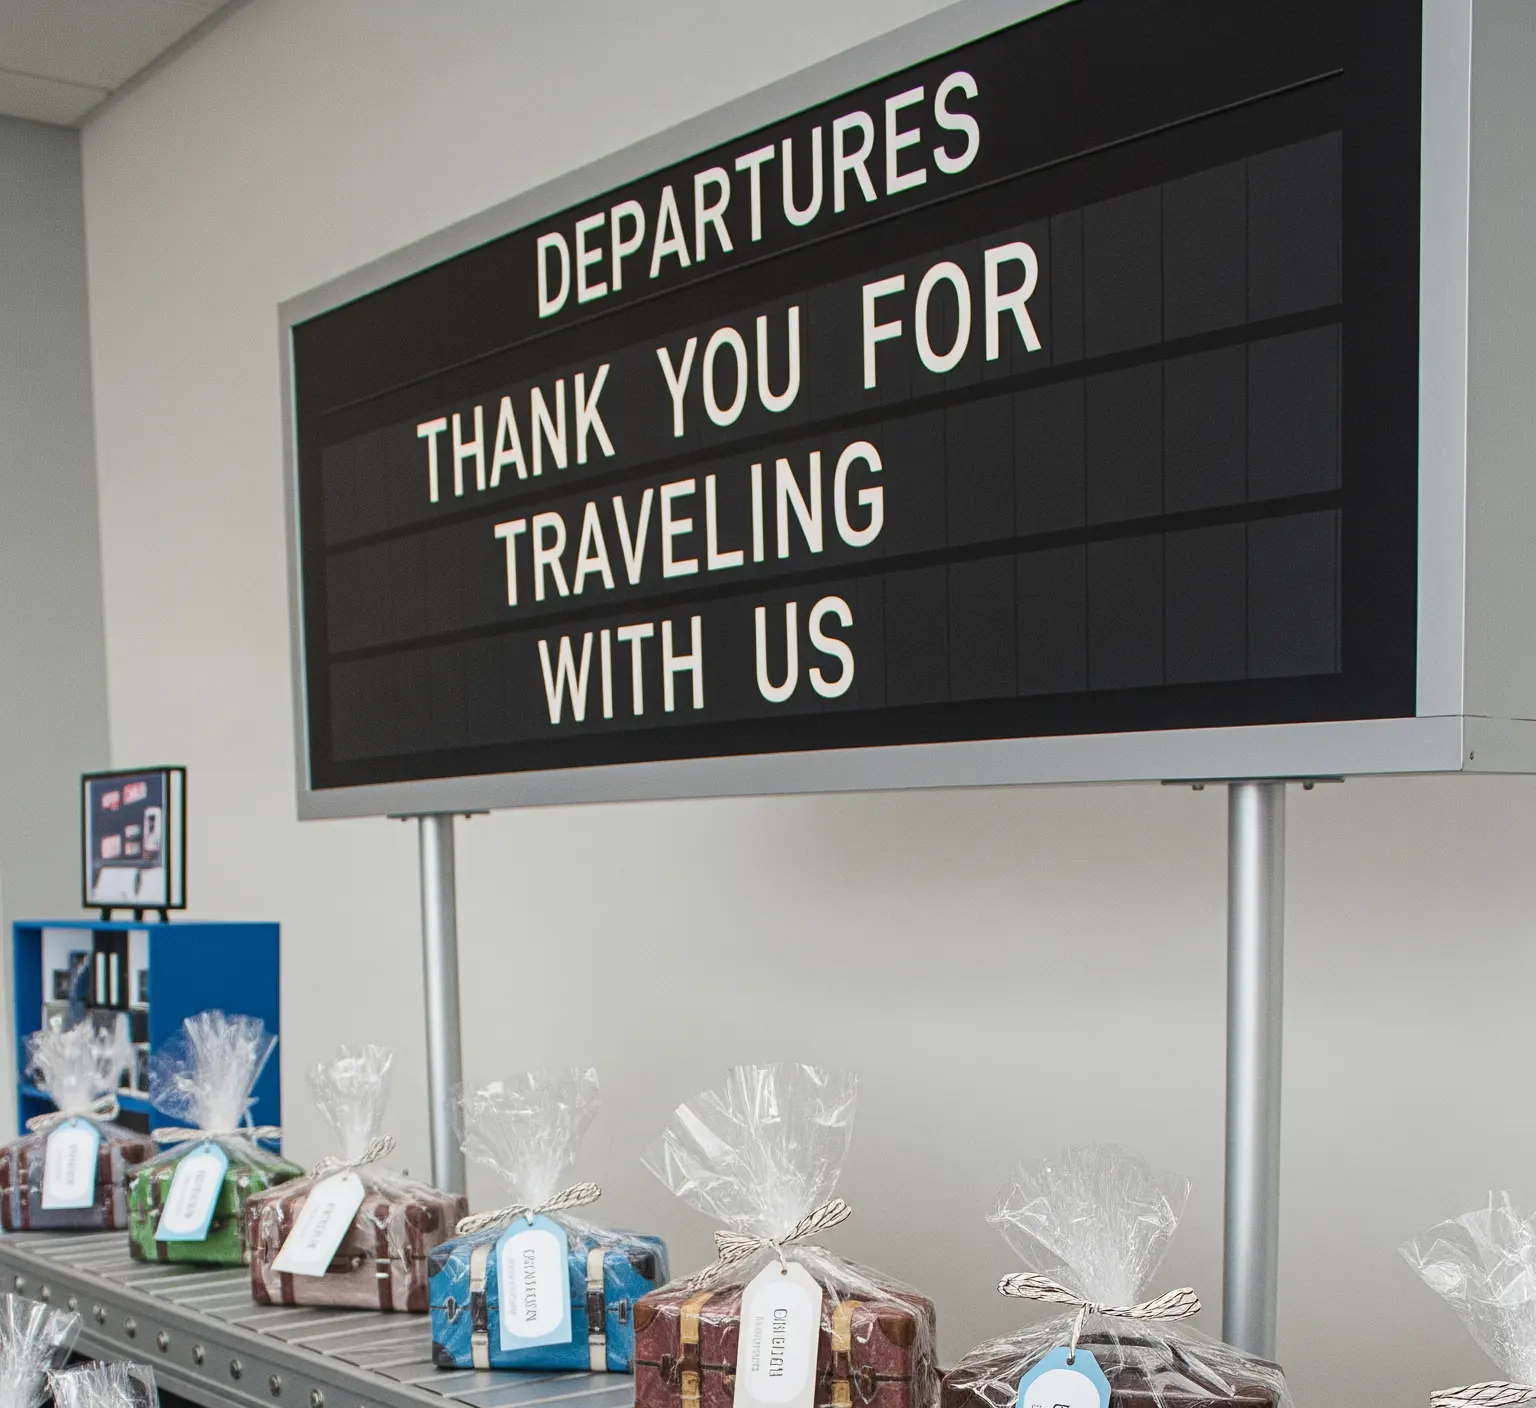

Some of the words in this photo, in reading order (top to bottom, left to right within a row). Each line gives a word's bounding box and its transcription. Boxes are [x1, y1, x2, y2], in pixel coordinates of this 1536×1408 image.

[537, 71, 980, 318] DEPARTURES
[416, 363, 616, 503] THANK
[656, 305, 801, 438] YOU
[862, 241, 1042, 390] FOR
[494, 441, 885, 607] TRAVELING
[537, 614, 704, 725] WITH
[754, 595, 855, 703] US
